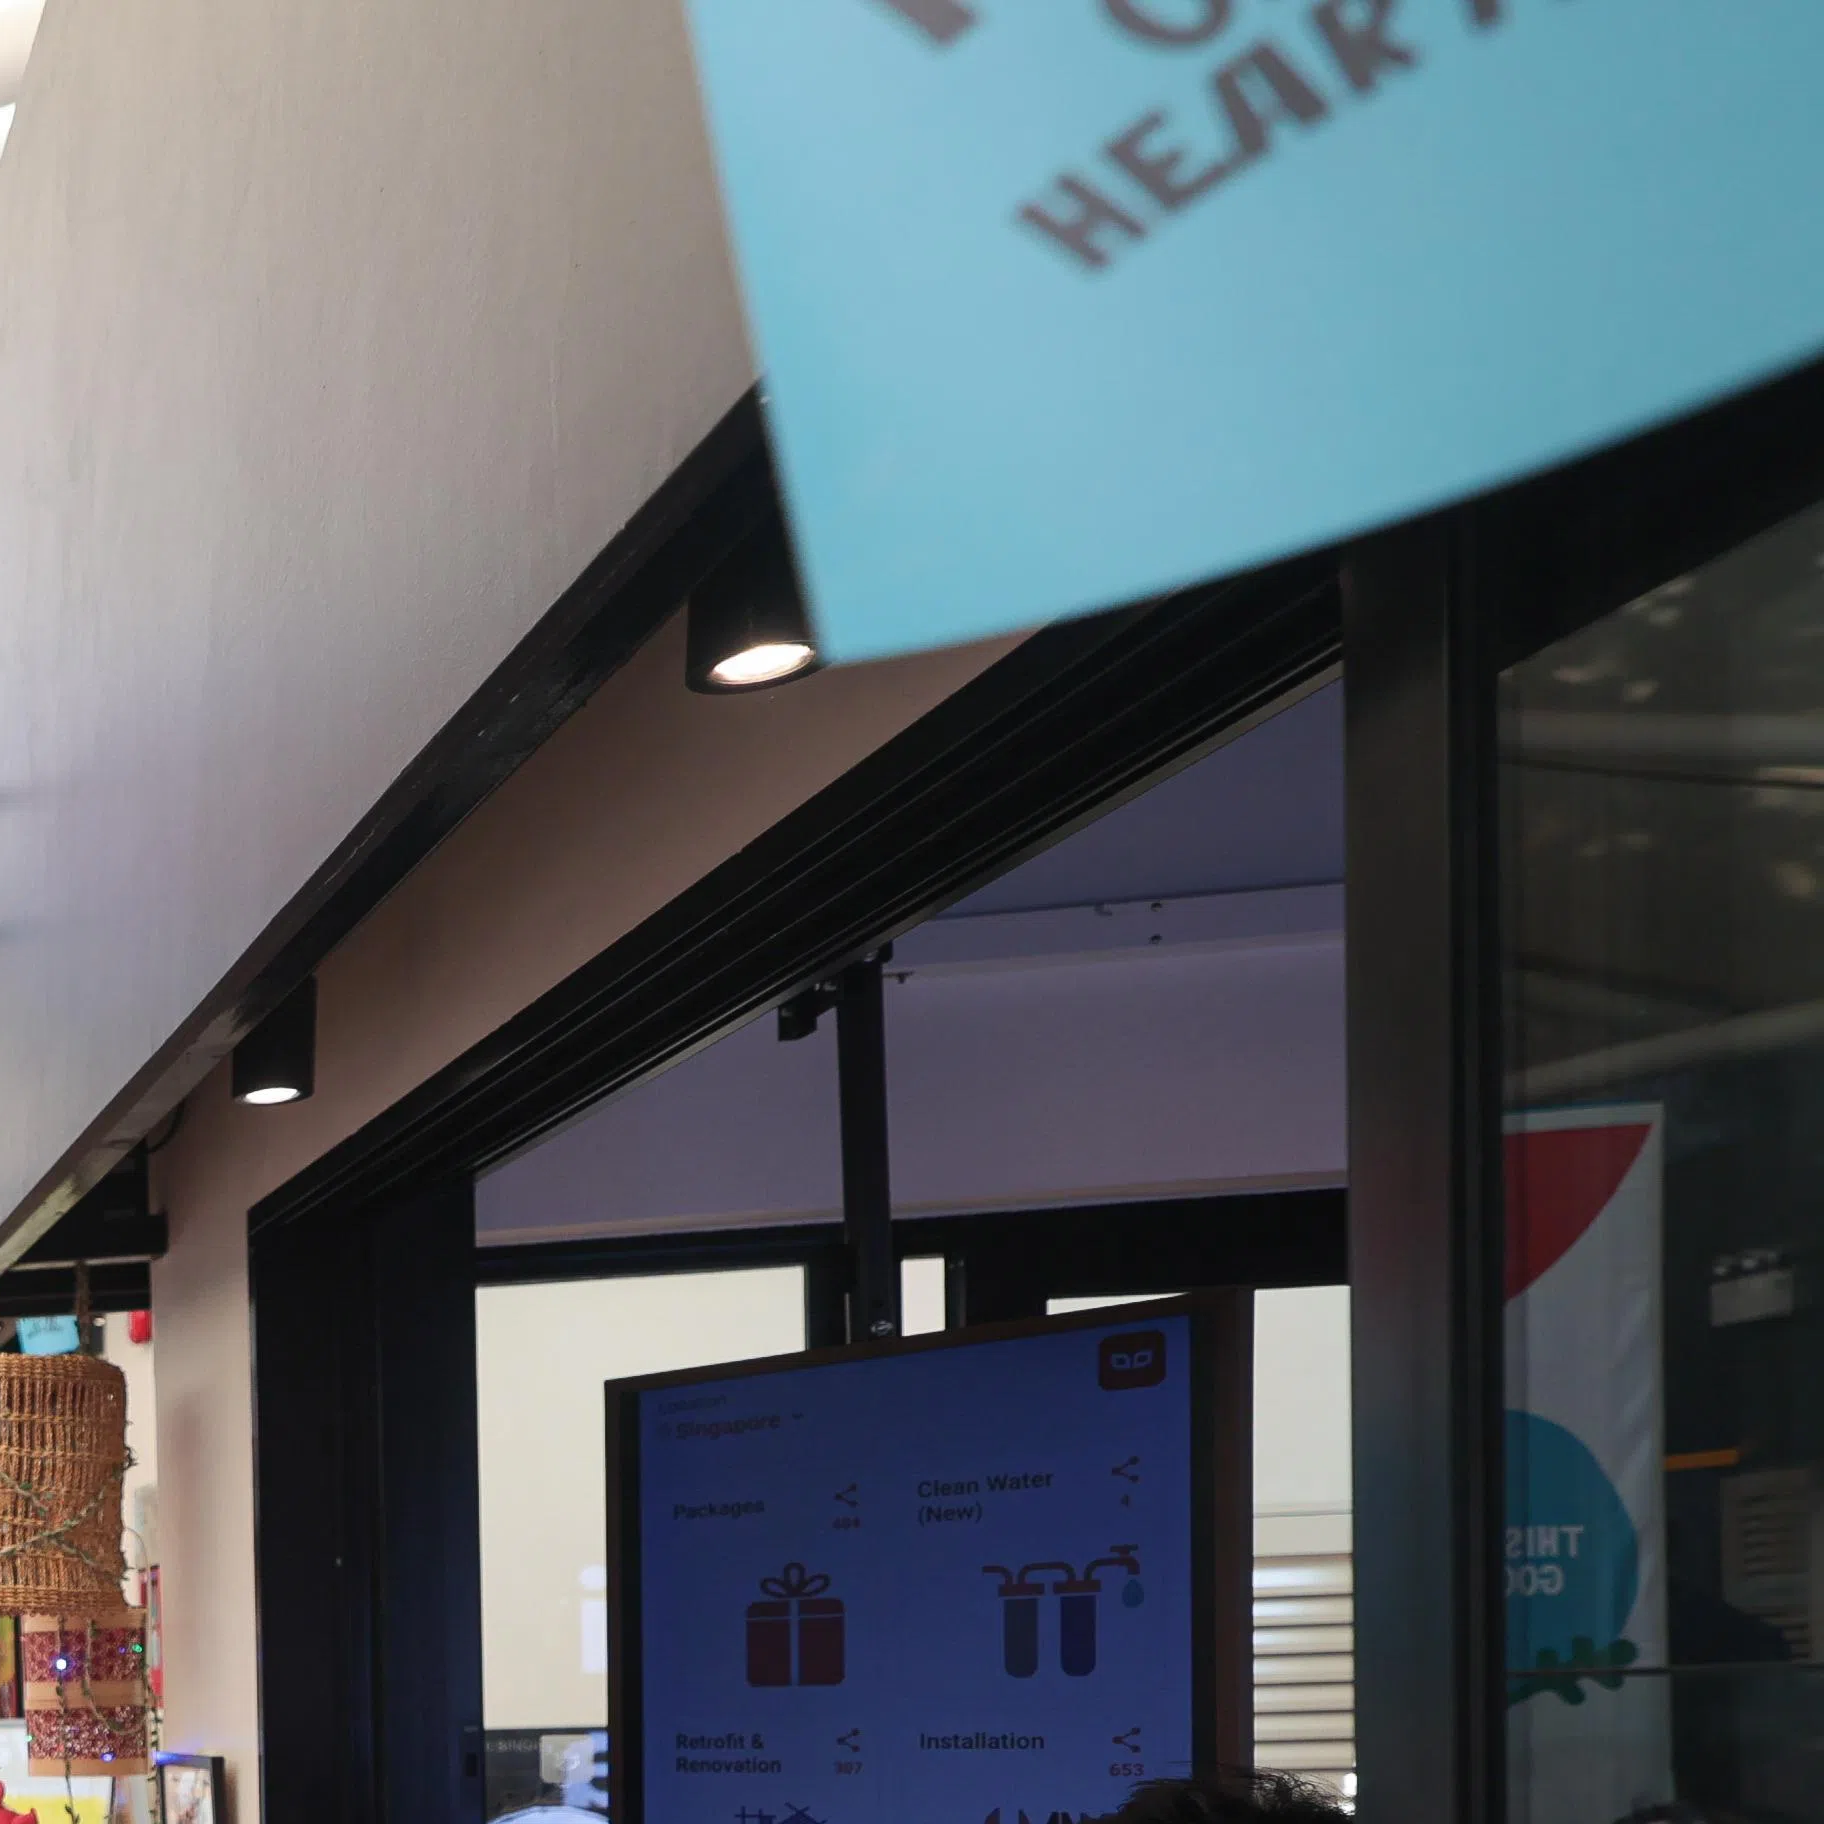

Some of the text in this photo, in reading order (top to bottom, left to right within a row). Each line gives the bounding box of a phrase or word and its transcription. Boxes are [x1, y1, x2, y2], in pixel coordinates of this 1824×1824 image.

[1009, 0, 1512, 274] HEAR
[676, 1414, 782, 1440] Singapore
[917, 1472, 1054, 1498] Clean Water
[673, 1500, 765, 1520] Packages
[917, 1501, 983, 1527] (New)
[675, 1733, 764, 1750] Retrofit &
[920, 1732, 1045, 1750] Installation
[675, 1756, 782, 1774] Renovation
[1109, 1763, 1145, 1777] 653
